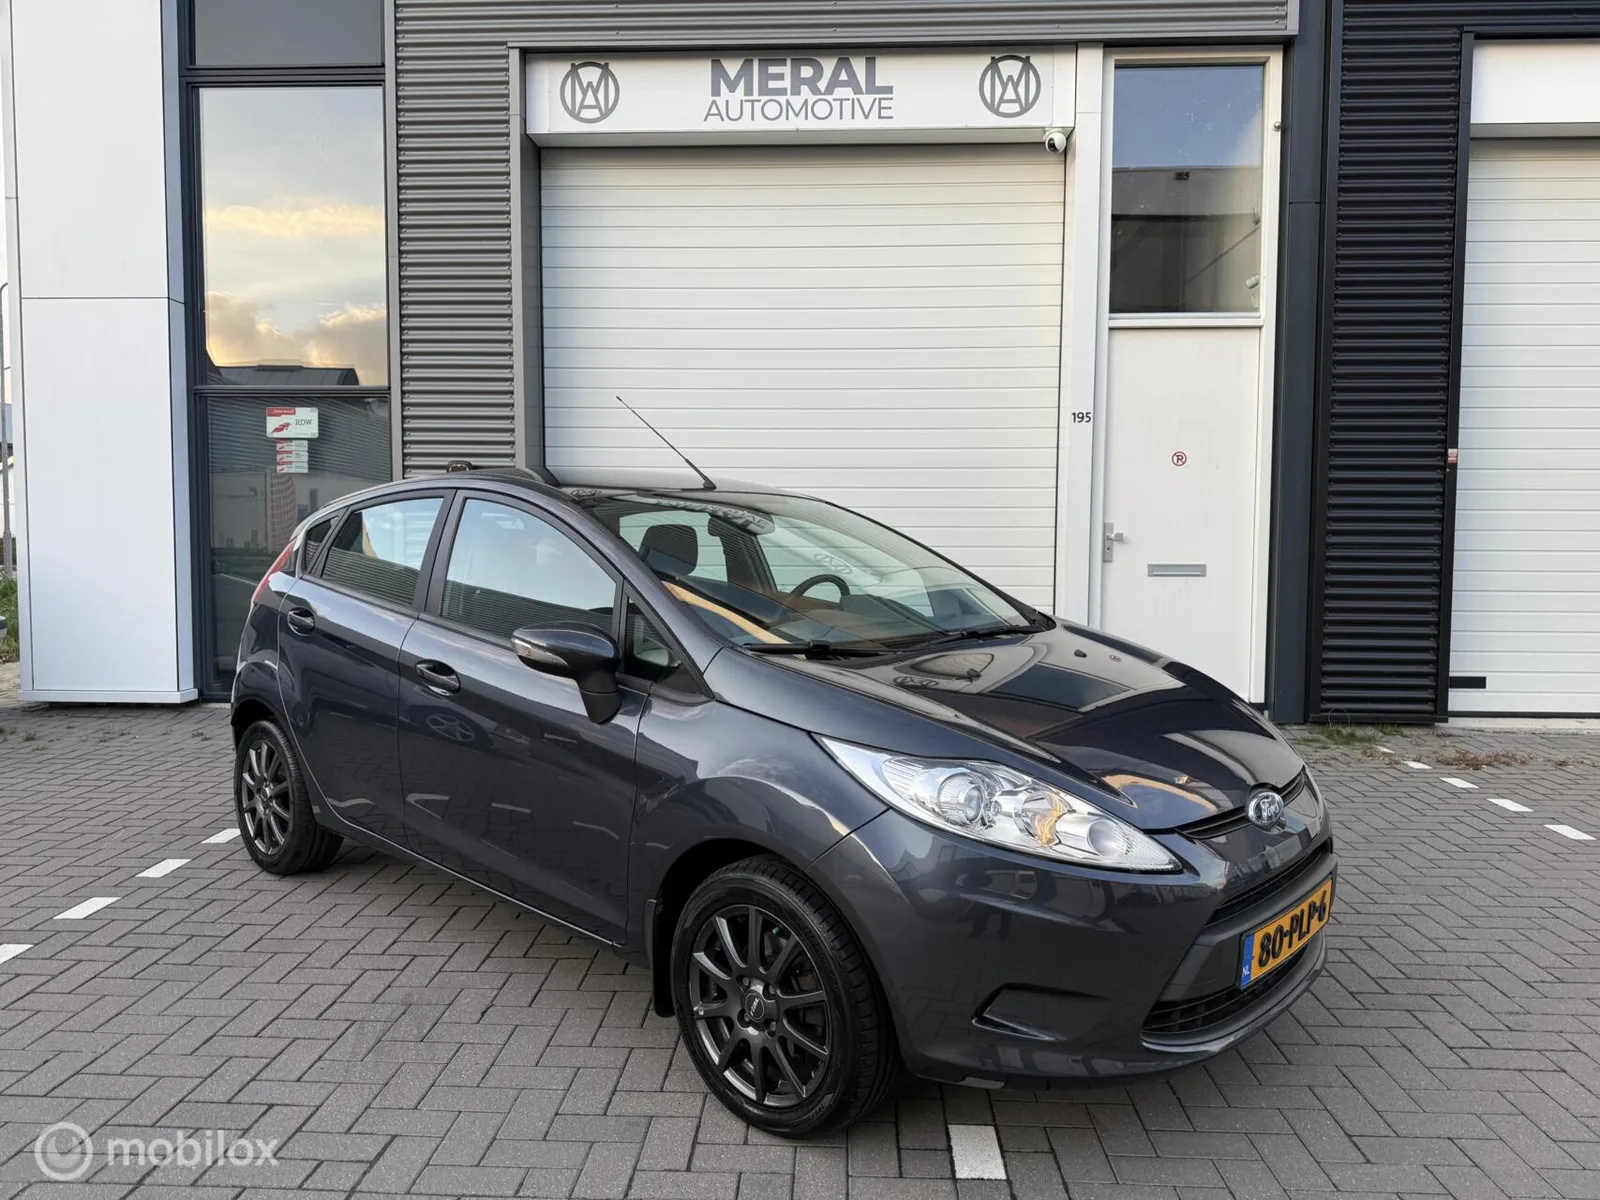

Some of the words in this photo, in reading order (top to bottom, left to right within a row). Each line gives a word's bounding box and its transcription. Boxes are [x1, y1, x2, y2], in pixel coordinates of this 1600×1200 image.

[711, 56, 894, 97] MERAL
[703, 97, 894, 122] AUTOMOTIVE
[294, 418, 312, 426] RDW
[1071, 411, 1092, 423] 195
[1258, 889, 1327, 968] 80-PLP-6
[1242, 964, 1250, 977] NL
